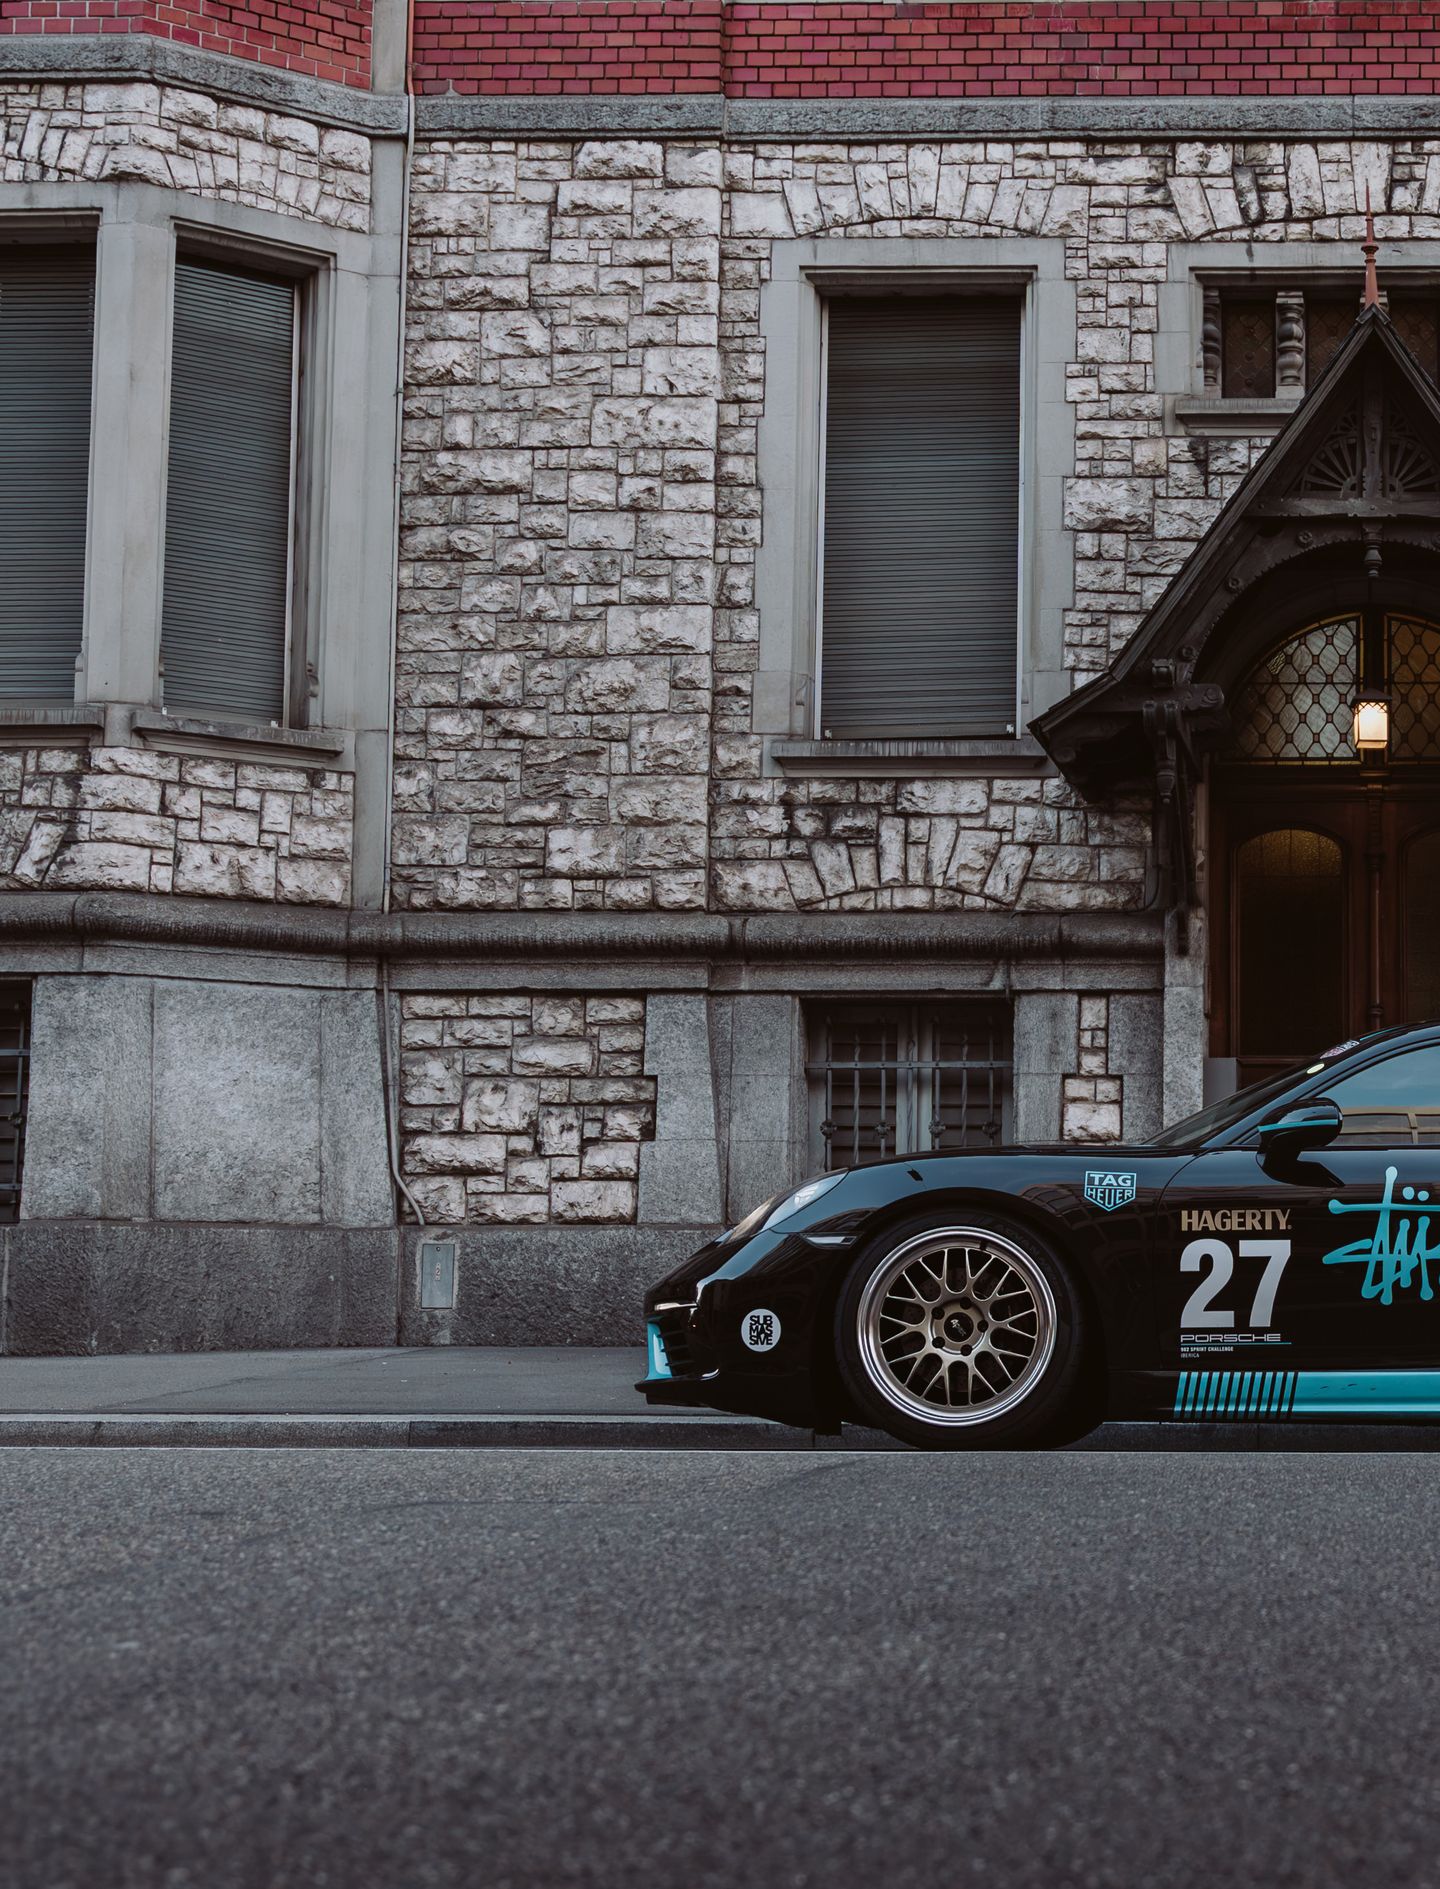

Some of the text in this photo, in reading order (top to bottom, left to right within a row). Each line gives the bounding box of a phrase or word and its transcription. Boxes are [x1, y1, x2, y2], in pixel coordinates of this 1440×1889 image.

[1089, 1174, 1132, 1187] TAG
[1087, 1188, 1133, 1208] HEUER
[1180, 1238, 1292, 1328] 27
[749, 1315, 773, 1326] SUB
[749, 1324, 773, 1337] MAS
[749, 1335, 774, 1346] SIVE
[1180, 1333, 1282, 1343] PORSCHE
